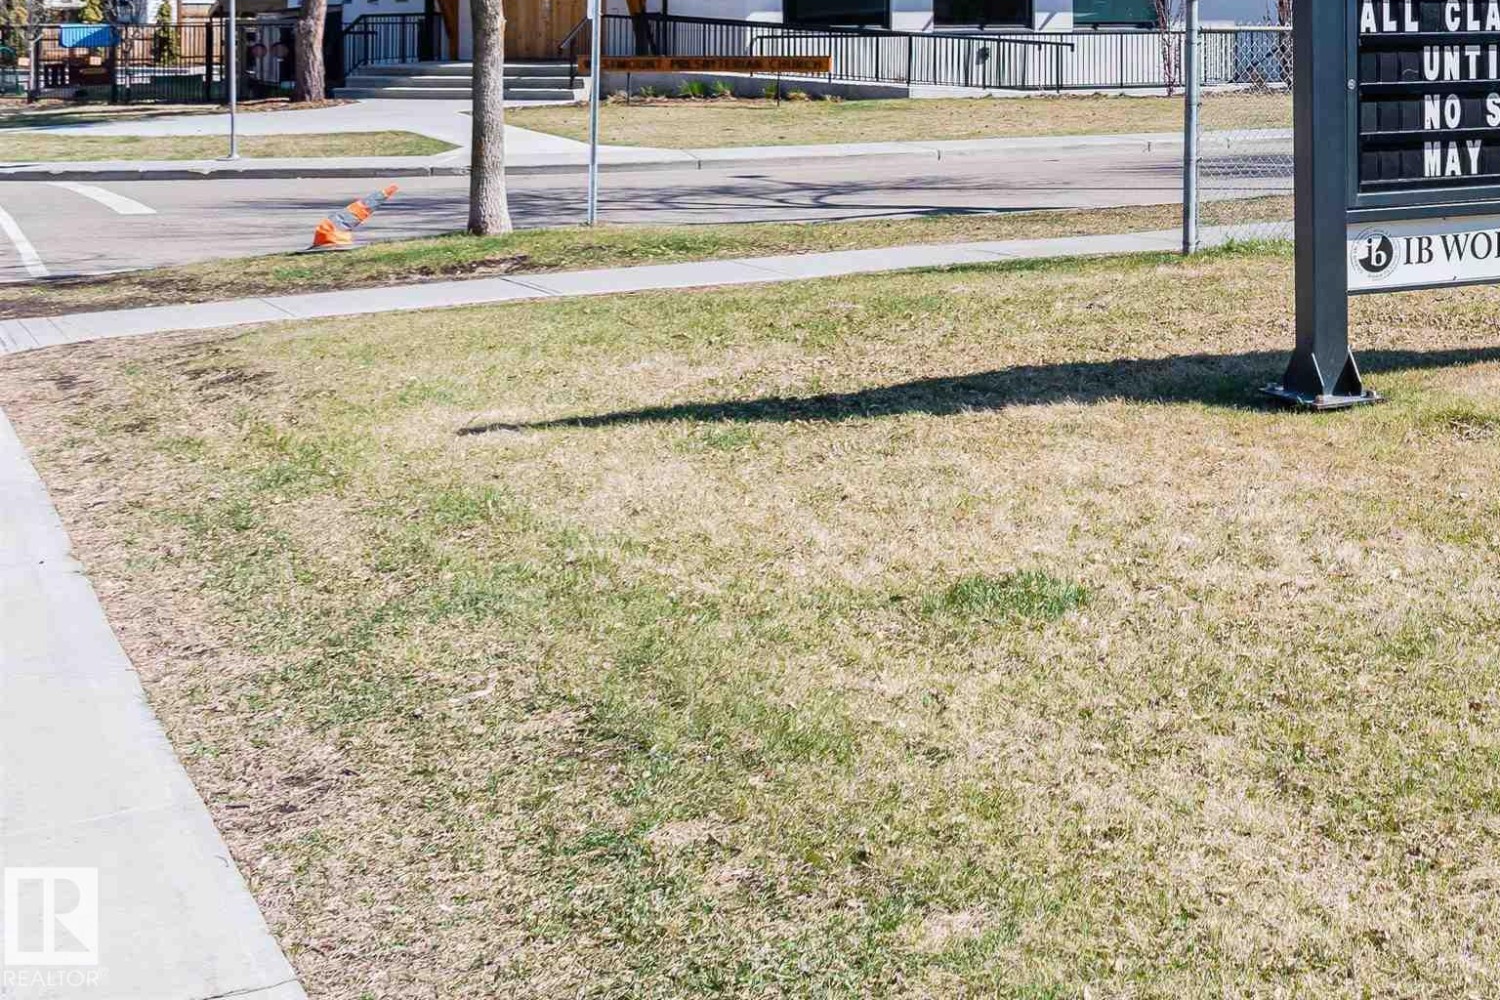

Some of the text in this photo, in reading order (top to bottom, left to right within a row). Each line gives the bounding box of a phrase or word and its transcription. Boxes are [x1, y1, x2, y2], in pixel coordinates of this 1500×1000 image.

[1424, 93, 1461, 130] NO
[1424, 139, 1482, 177] MAY
[1403, 236, 1434, 265] IB
